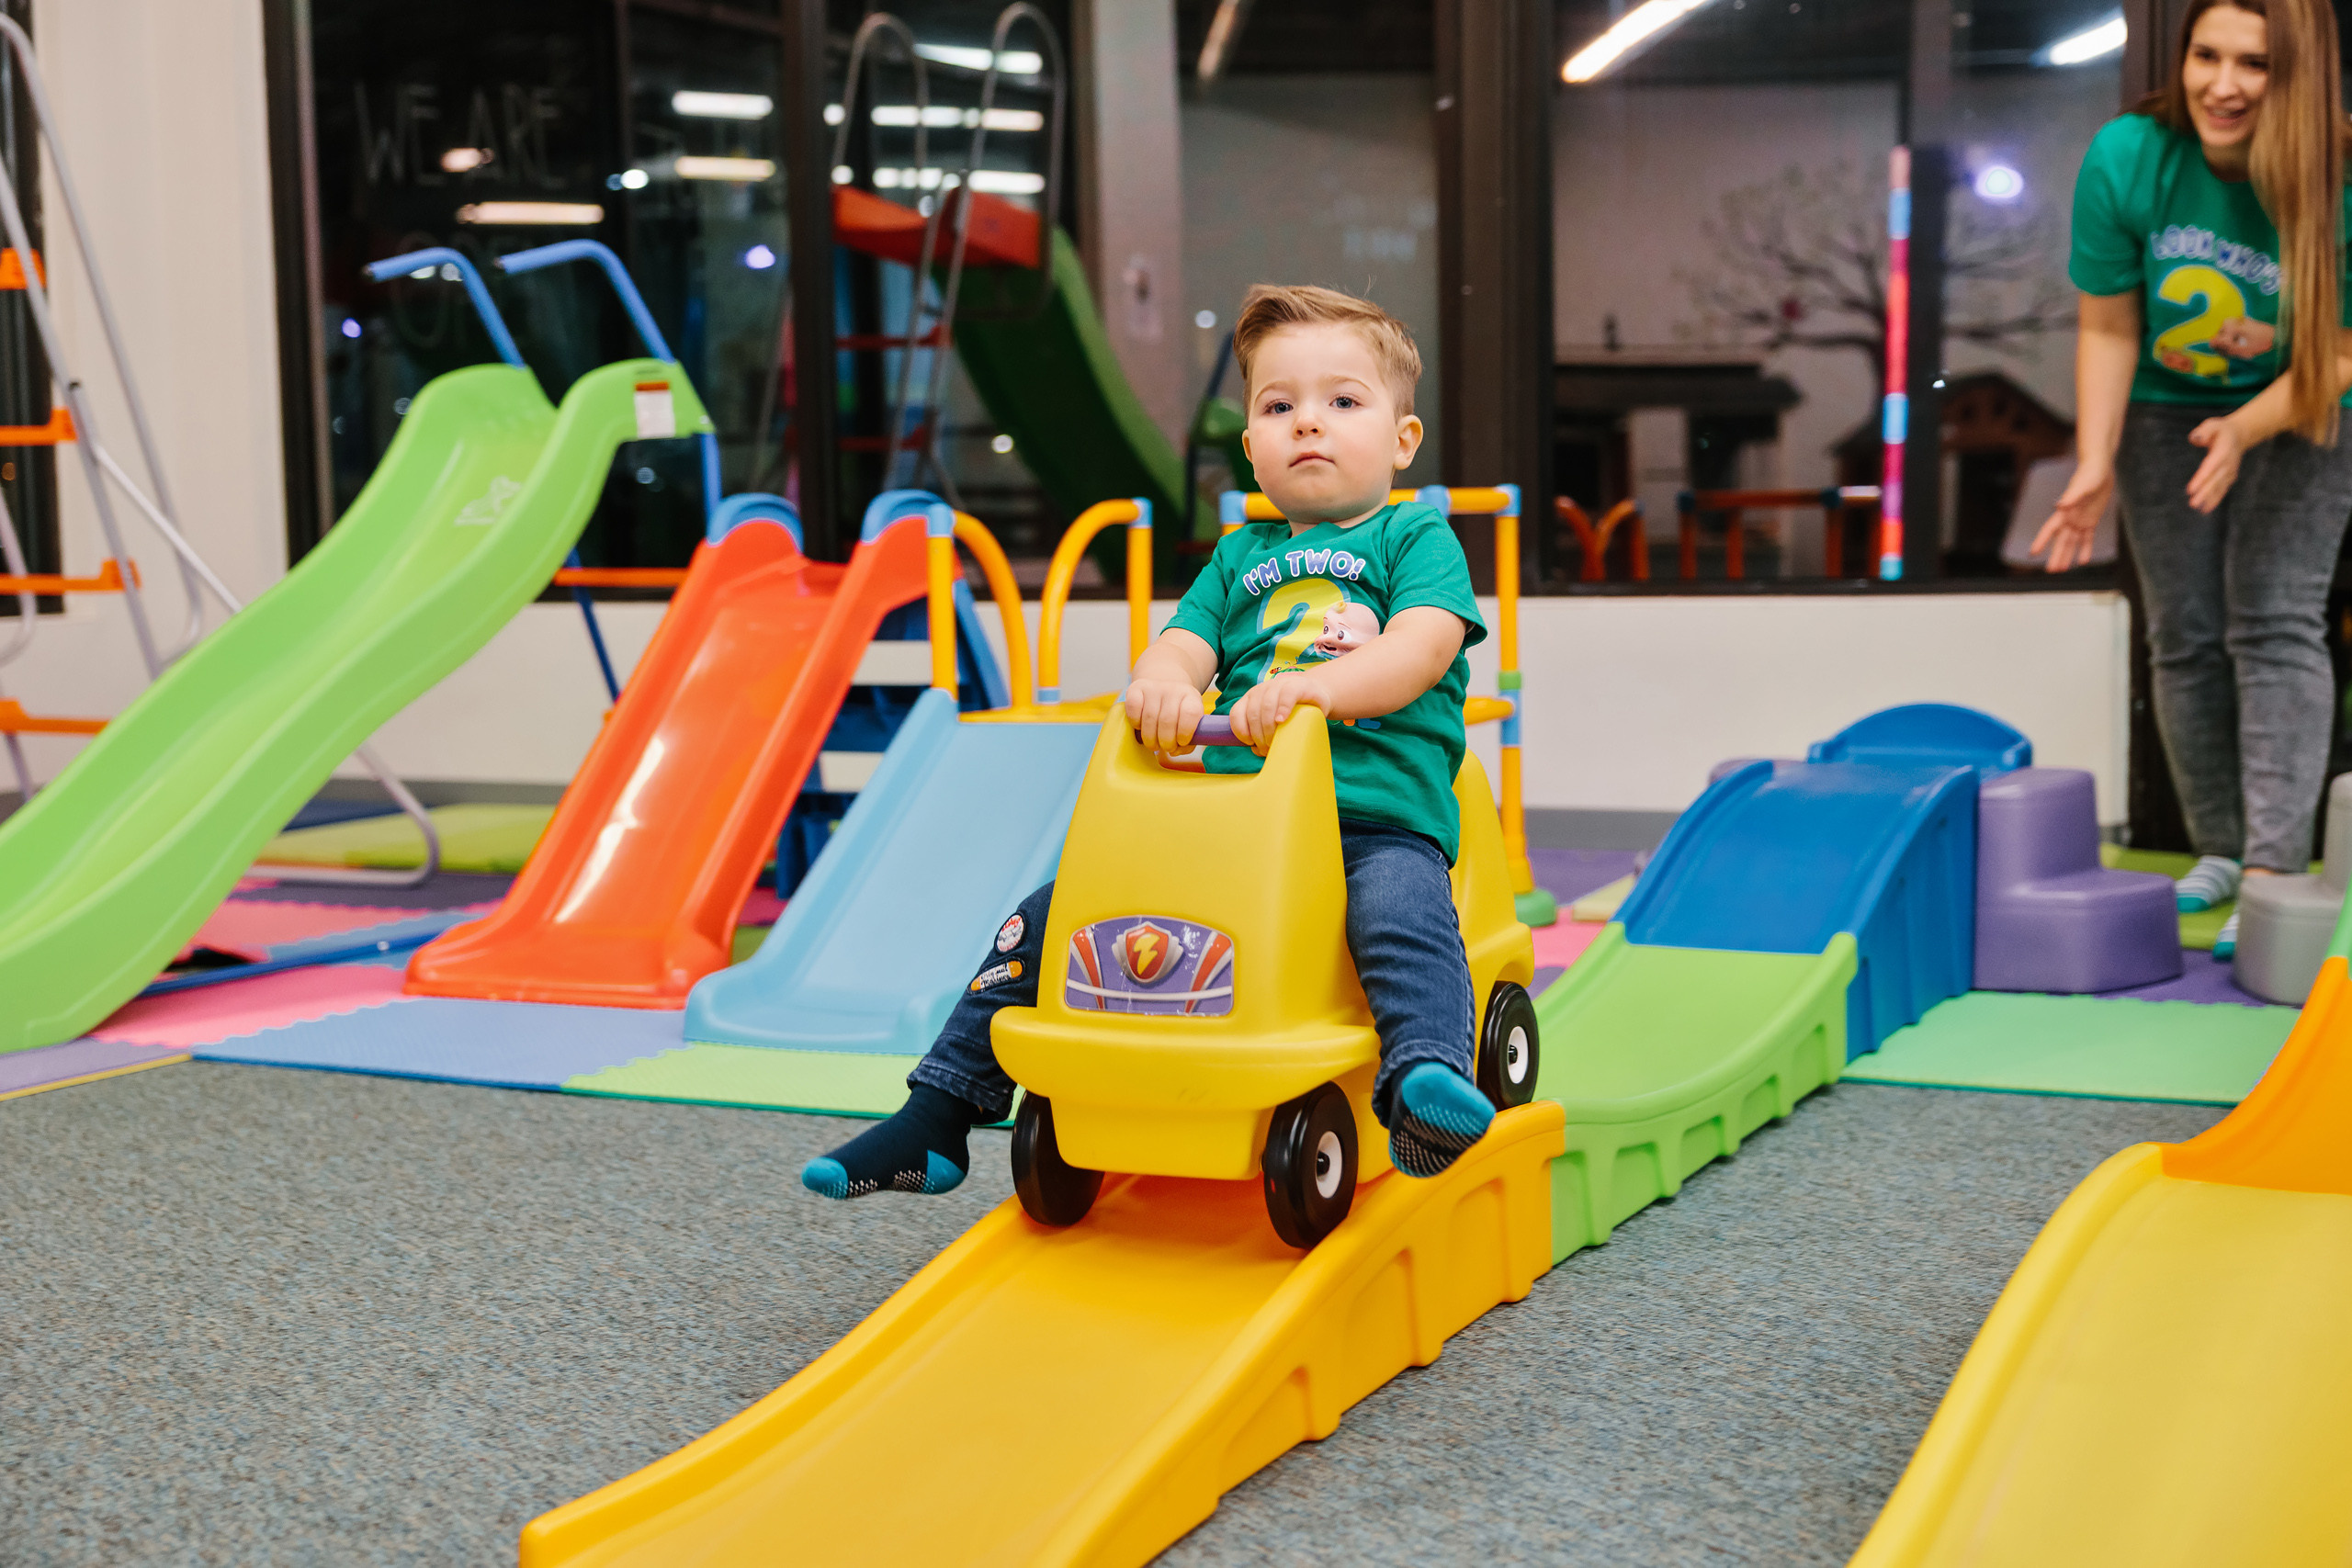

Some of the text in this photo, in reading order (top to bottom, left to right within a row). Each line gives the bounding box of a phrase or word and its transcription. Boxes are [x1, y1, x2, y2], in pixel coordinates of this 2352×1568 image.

[353, 80, 445, 186] WE
[2152, 264, 2248, 378] 2
[1242, 548, 1366, 595] I'M TWO!
